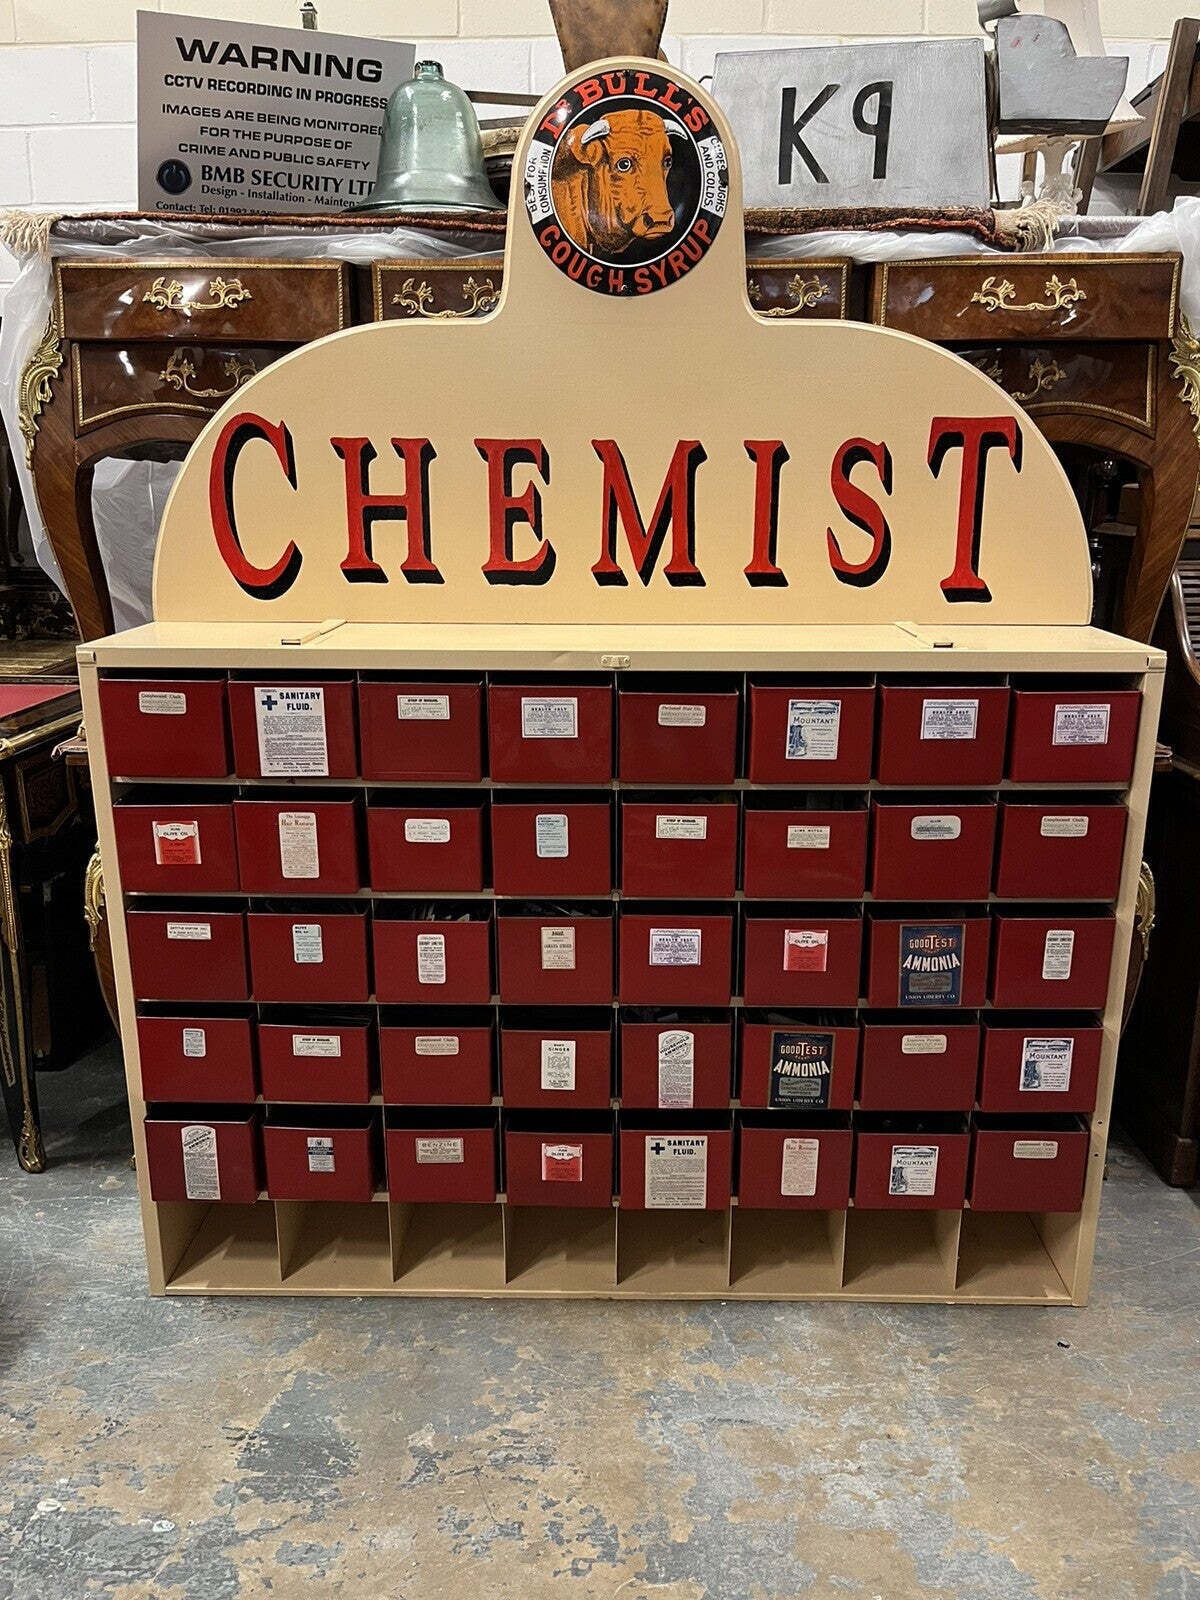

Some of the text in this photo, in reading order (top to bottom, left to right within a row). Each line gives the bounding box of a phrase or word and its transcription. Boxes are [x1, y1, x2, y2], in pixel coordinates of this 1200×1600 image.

[175, 37, 383, 83] WARNING
[164, 74, 388, 109] CCTV RECORDING IN PROGRESS
[573, 72, 711, 134] BULL'S
[162, 103, 221, 119] IMAGES
[223, 110, 254, 122] ARE
[257, 112, 301, 127] BEING
[199, 126, 353, 151] FOR THE PURPOSE OF
[178, 142, 371, 171] CRIME AND PUBLIC SAFETY
[527, 157, 537, 178] FOR
[201, 164, 245, 184] BMB
[251, 169, 344, 193] SECURITY
[700, 145, 716, 208] AND COLDS.
[155, 200, 196, 212] Contact:
[201, 184, 360, 208] Design Installation Mainten
[539, 218, 715, 294] COUGH SYRUP
[209, 411, 1023, 604] CHEMIST
[279, 692, 321, 700] SANITARY
[286, 703, 313, 711] FLUID.
[902, 952, 961, 972] AMMONIA
[660, 1035, 690, 1054] HOUSEHOLD
[1029, 1052, 1068, 1060] MOUNTANT
[773, 1058, 830, 1077] AMMONIA
